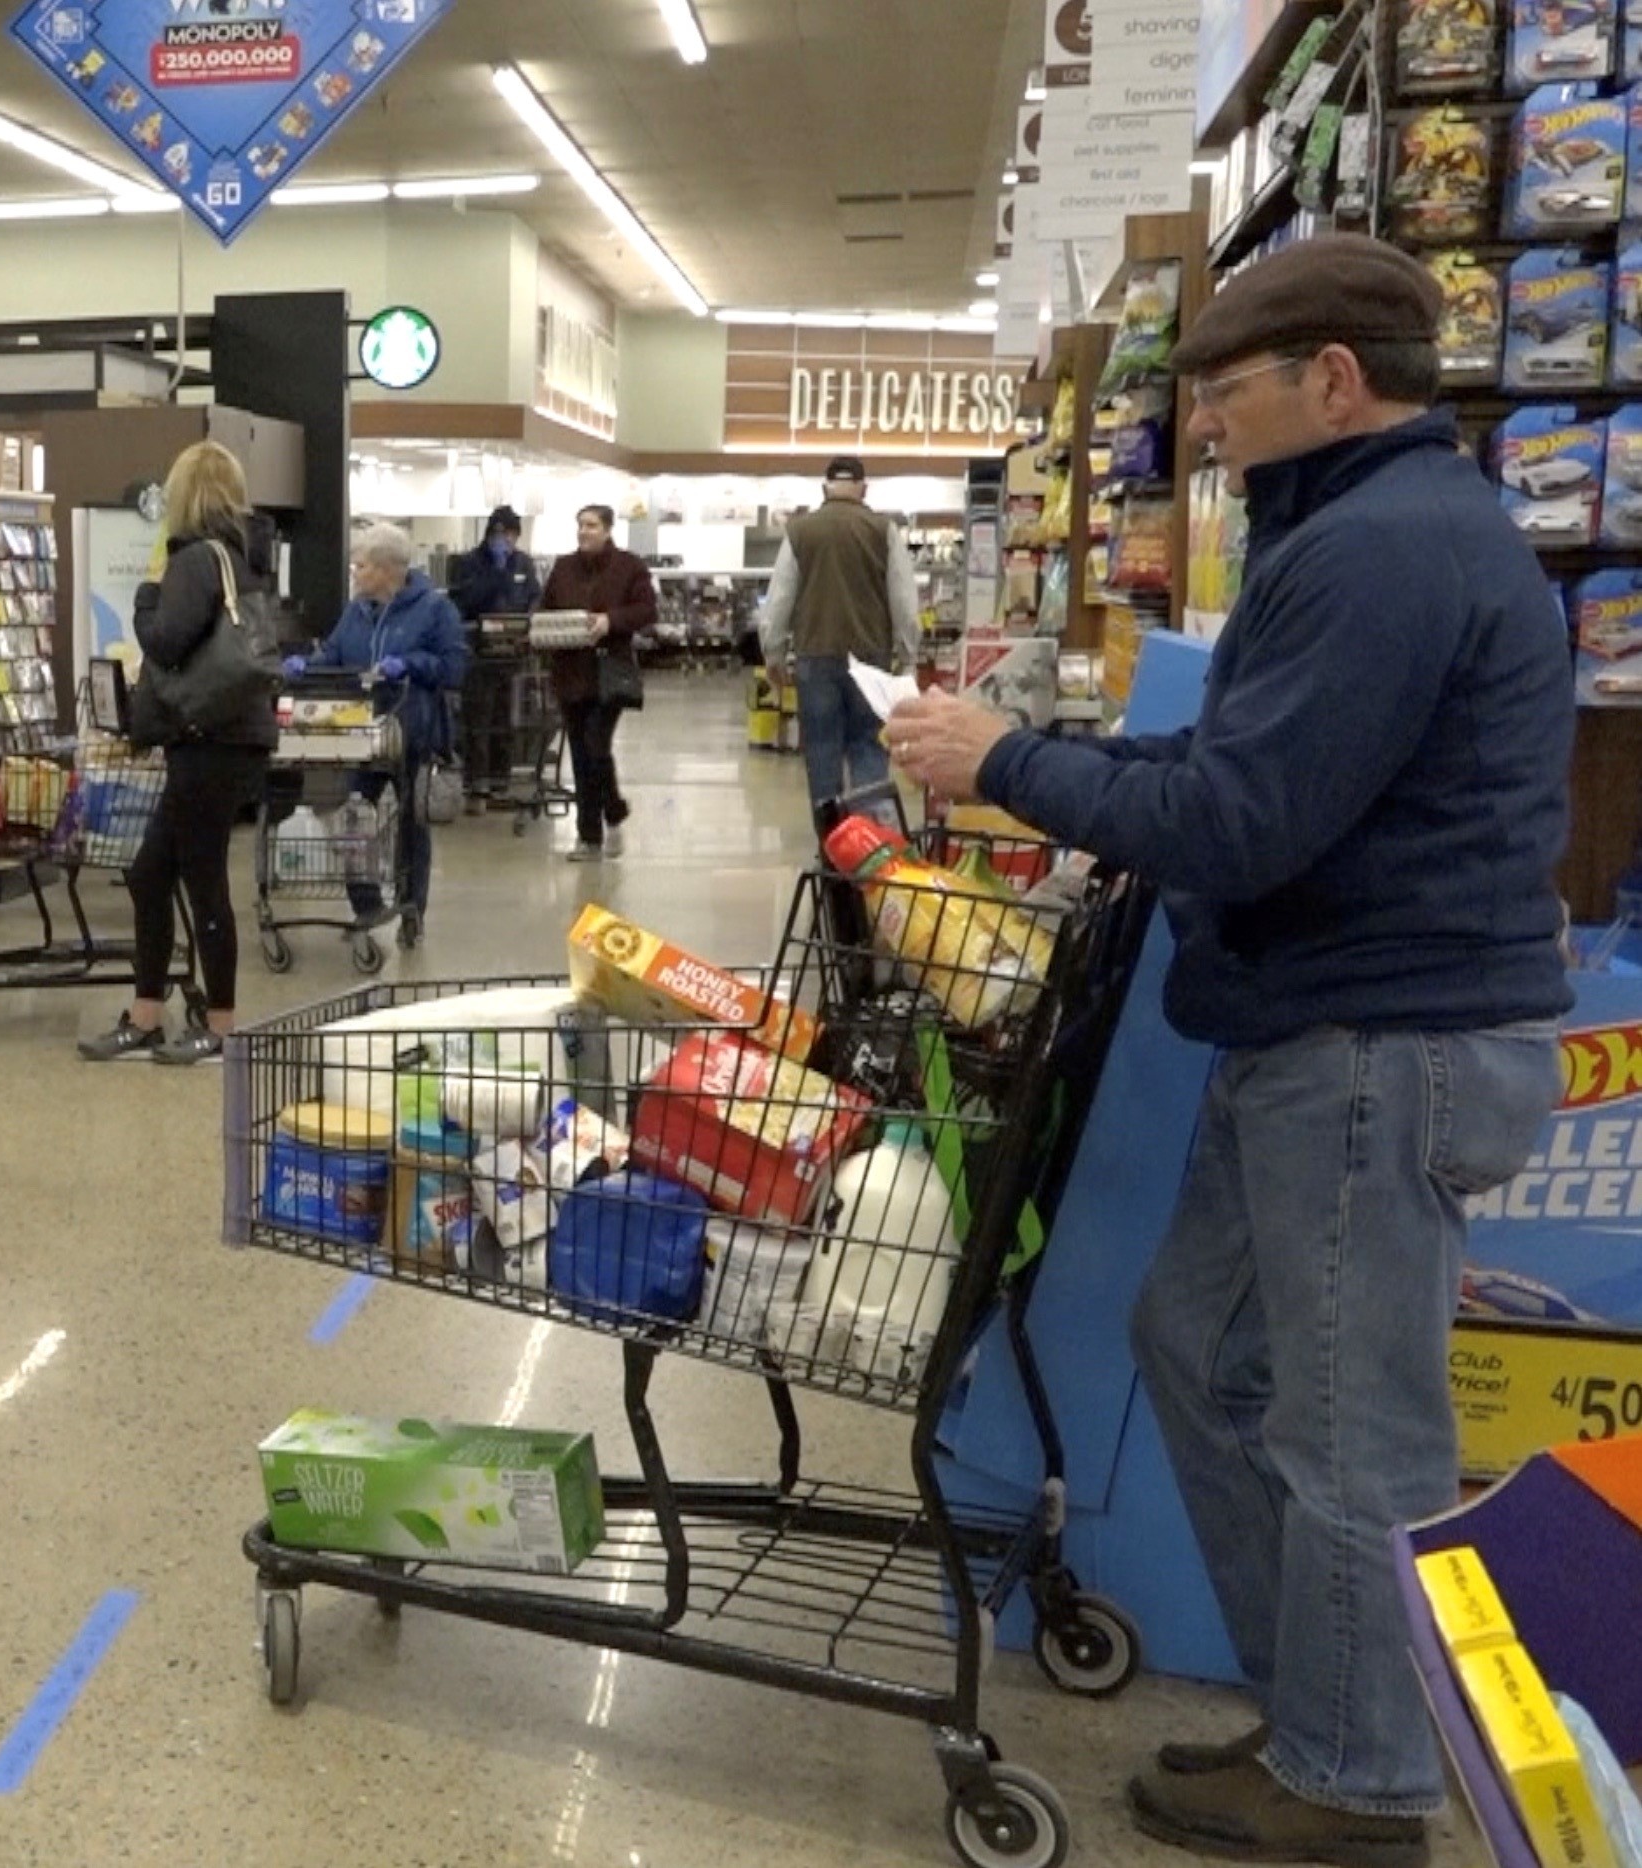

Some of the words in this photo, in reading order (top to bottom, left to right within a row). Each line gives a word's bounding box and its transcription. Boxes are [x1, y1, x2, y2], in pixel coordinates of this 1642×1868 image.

[166, 21, 279, 45] MONOPOLY
[1124, 15, 1201, 37] shaving
[1149, 50, 1199, 72] dige
[1124, 86, 1197, 105] feminin
[206, 181, 243, 206] GO
[789, 366, 1044, 436] DELICATESS
[674, 957, 747, 1002] HONEY
[657, 969, 746, 1022] ROASTED
[1448, 1350, 1504, 1371] Club
[293, 1462, 367, 1493] SELTZER
[301, 1488, 364, 1520] WATER
